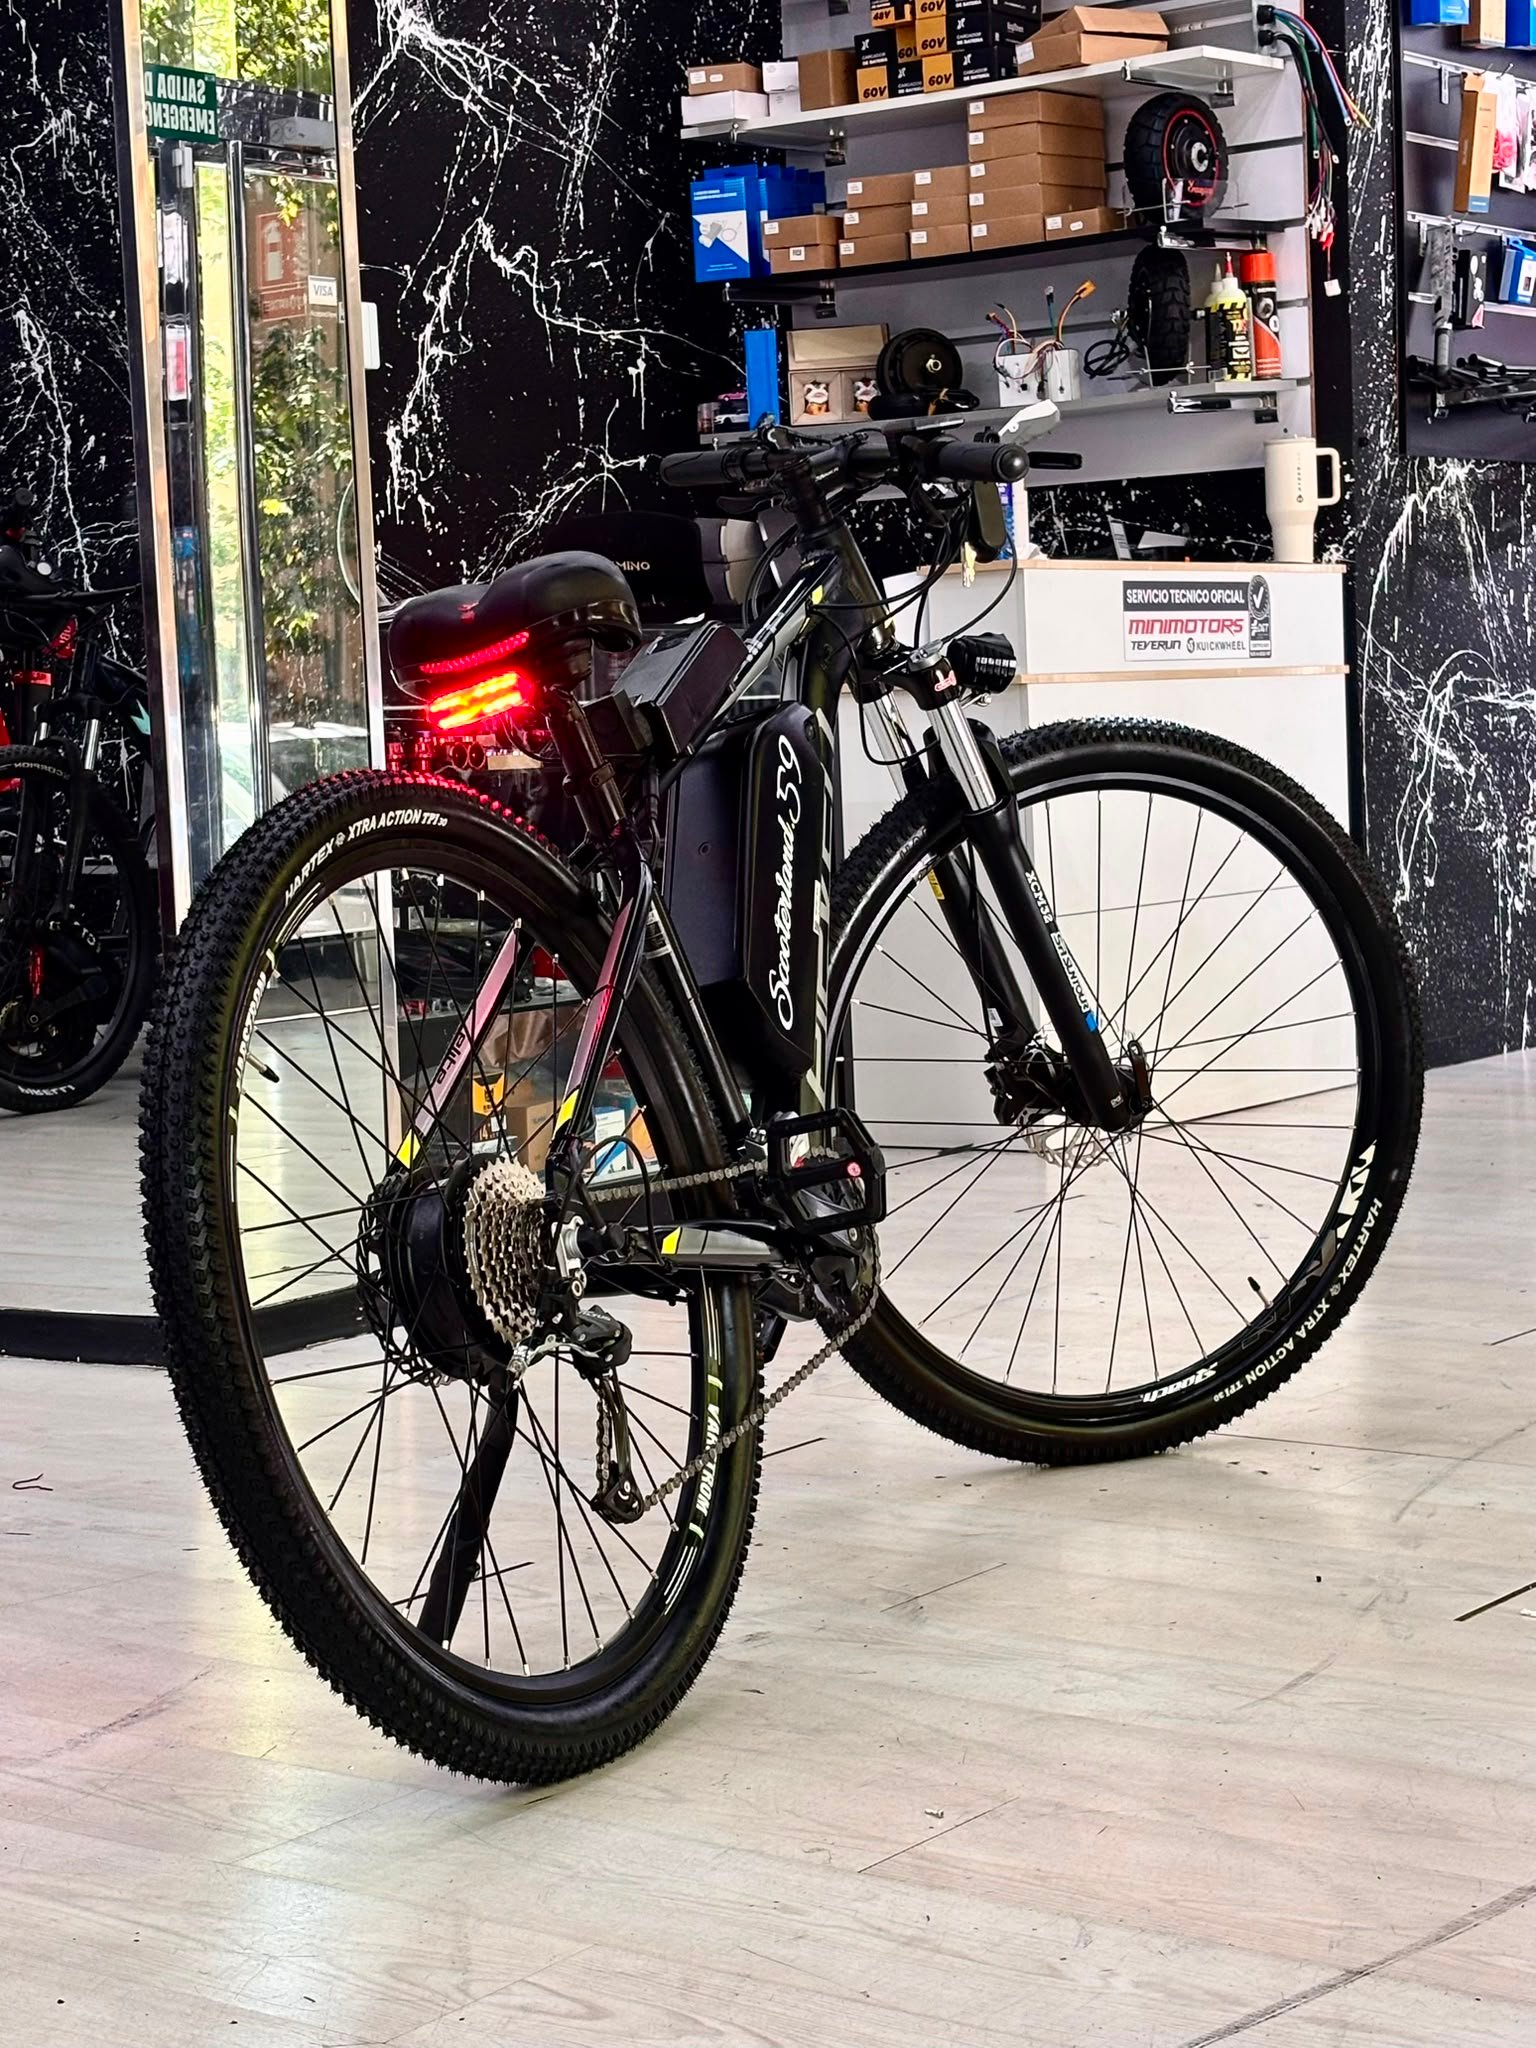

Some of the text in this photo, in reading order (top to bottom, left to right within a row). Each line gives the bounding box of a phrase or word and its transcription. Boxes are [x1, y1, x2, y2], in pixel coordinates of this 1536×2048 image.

[920, 0, 944, 13] 60V
[873, 10, 891, 20] 48V
[921, 37, 945, 50] 60V
[928, 73, 952, 86] 60V
[863, 86, 887, 98] 60V
[313, 284, 334, 297] VISA
[1126, 588, 1245, 604] SERVICIO TECNICO OFICIAL
[1128, 618, 1244, 636] MINIMOTORS
[1130, 640, 1181, 652] TEVERUN
[284, 838, 336, 908] HARTEX
[347, 817, 376, 842] XTRA
[377, 809, 423, 828] ACTION
[437, 1029, 466, 1085] elite
[1337, 1198, 1383, 1284] HARTEX
[1296, 1298, 1330, 1338] XTRA
[1245, 1337, 1295, 1385] ACTION
[696, 1403, 722, 1518] VARTROM
